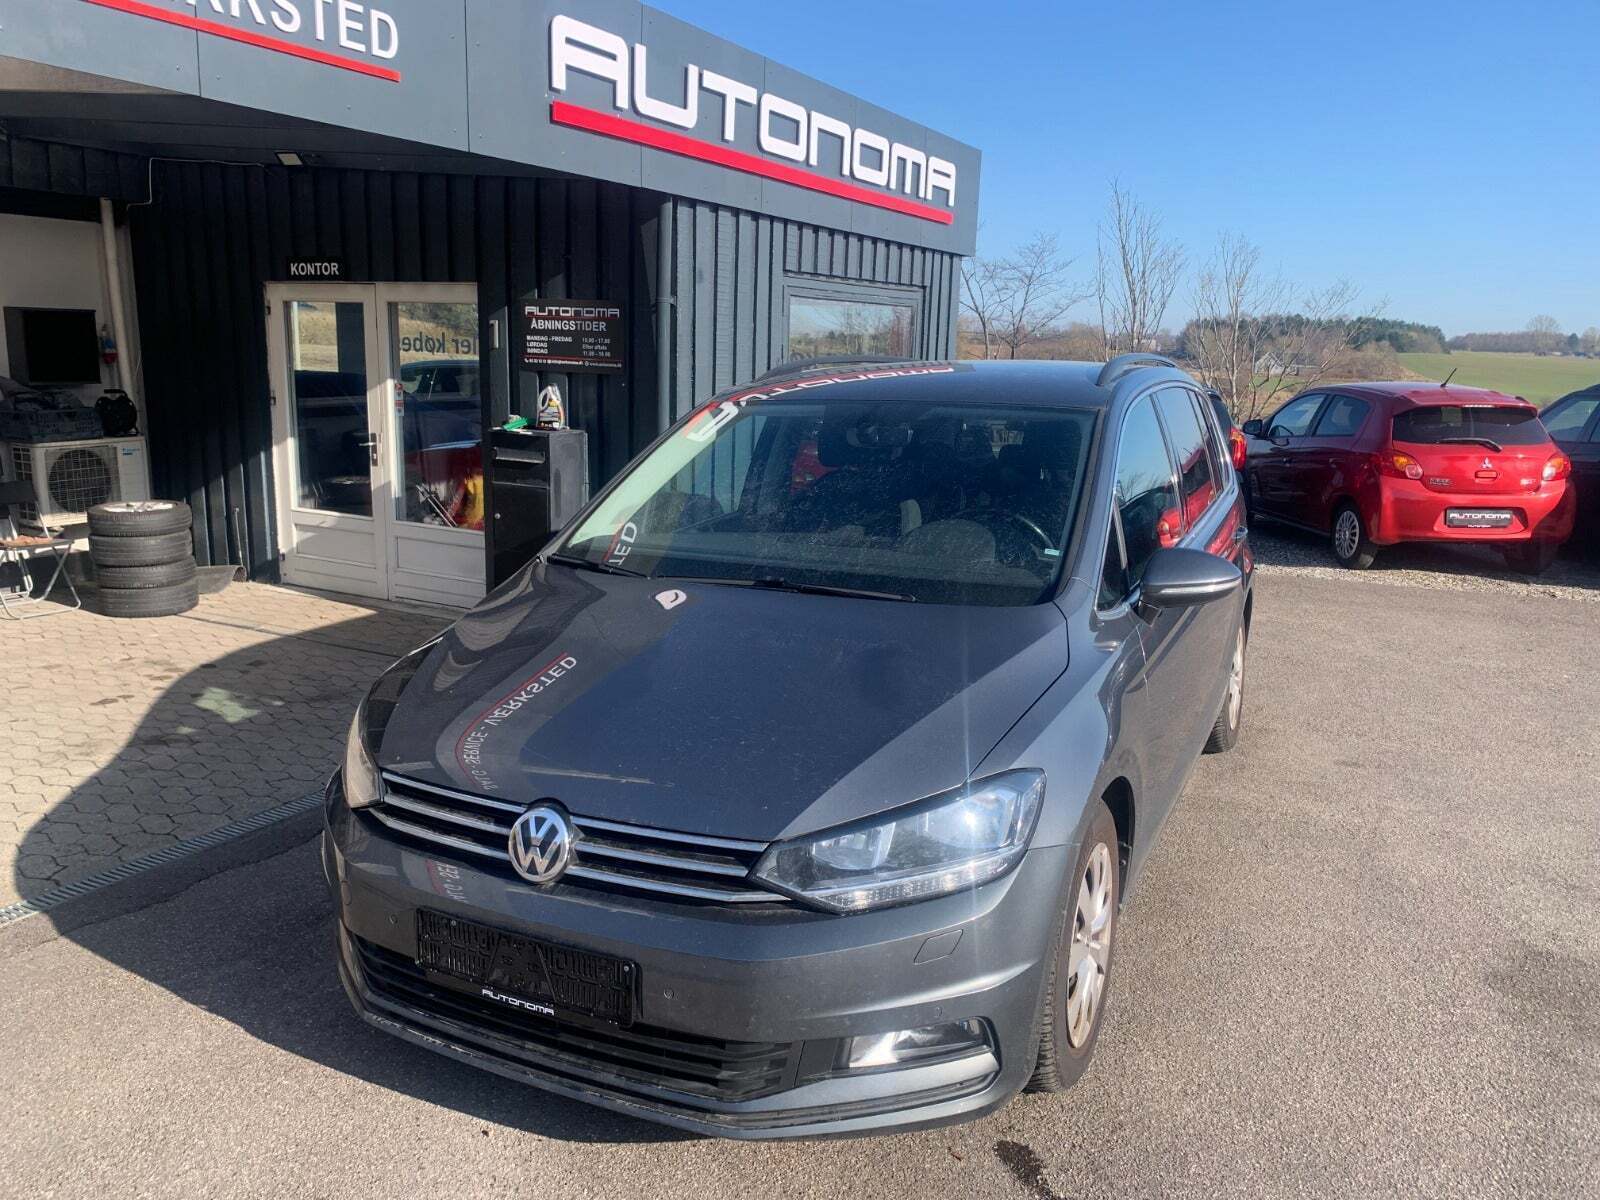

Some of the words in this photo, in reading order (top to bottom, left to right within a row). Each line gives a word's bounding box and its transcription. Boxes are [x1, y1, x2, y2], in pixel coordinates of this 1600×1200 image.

[184, 0, 399, 60] STED
[549, 14, 957, 207] AUTONOMA
[290, 262, 340, 276] KONTOR
[524, 305, 620, 318] AUTONOMA
[530, 318, 607, 332] ÅBNINGSTIDER
[481, 988, 555, 1016] AUTONOMA
